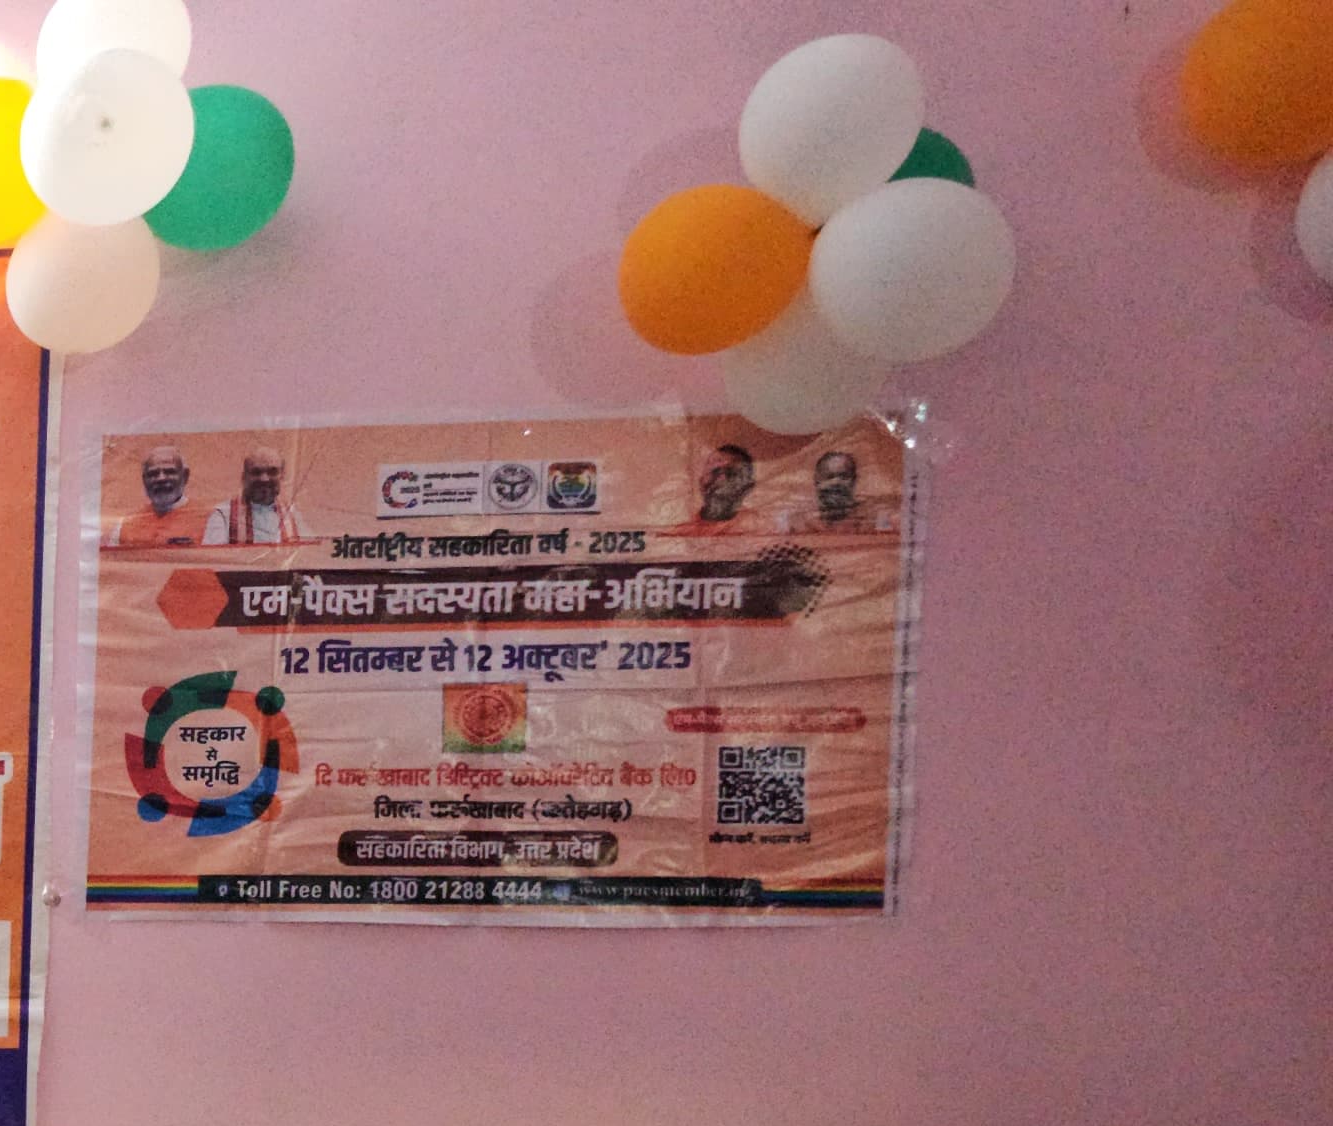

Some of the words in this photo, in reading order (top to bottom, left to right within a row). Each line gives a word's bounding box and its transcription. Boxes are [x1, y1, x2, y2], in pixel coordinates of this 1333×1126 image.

[428, 527, 533, 557] सहकारिता
[537, 527, 568, 554] वर्ष
[589, 531, 646, 553] 2025
[383, 579, 517, 615] सदस्यता
[281, 647, 310, 674] 12
[316, 639, 426, 674] सितम्बर
[428, 637, 459, 671] से
[464, 644, 492, 673] 12
[617, 642, 690, 670] 2025
[179, 726, 247, 744] सहकार
[205, 747, 218, 761] से
[182, 761, 240, 787] समृद्धि
[315, 763, 333, 786] दि
[356, 835, 447, 859] सहकारिता
[515, 838, 552, 860] उत्तर
[557, 834, 600, 860] प्रदेश
[237, 880, 271, 898] Toll
[279, 881, 322, 898] Free
[330, 881, 361, 898] No:
[370, 881, 418, 899] 1800
[425, 881, 485, 899] 21288
[492, 881, 543, 900] 4444
